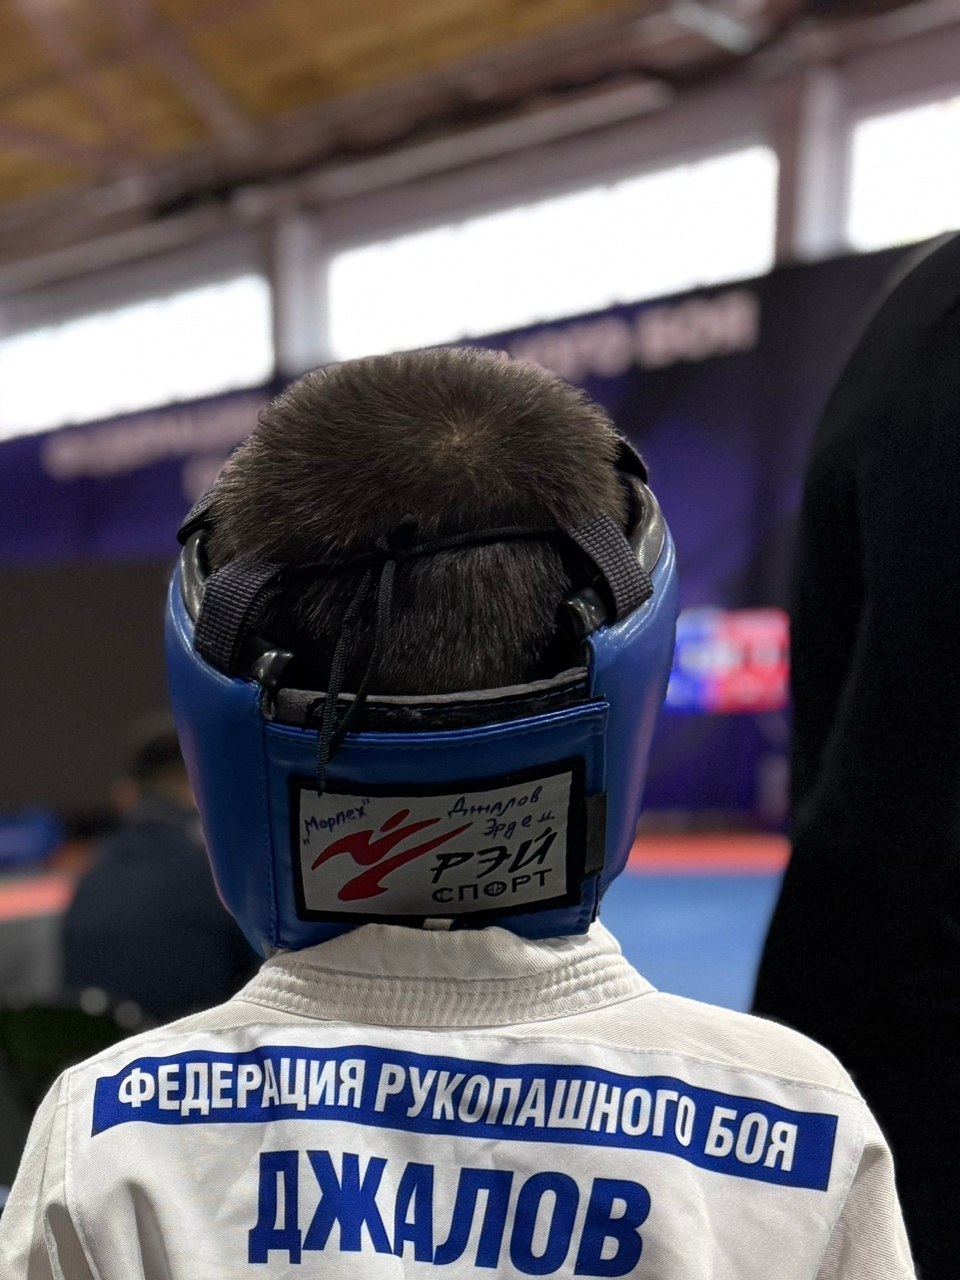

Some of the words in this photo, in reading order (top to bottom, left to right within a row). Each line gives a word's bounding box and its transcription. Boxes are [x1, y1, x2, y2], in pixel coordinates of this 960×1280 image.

[430, 826, 558, 884] РЭЙ
[431, 868, 553, 903] СПОРТ
[118, 1059, 366, 1117] ФЕДЕРАЦИЯ
[375, 1065, 693, 1147] РУКОПАШНОГО
[704, 1107, 798, 1172] БОЯ
[248, 1150, 652, 1278] ДЖАЛОВ
